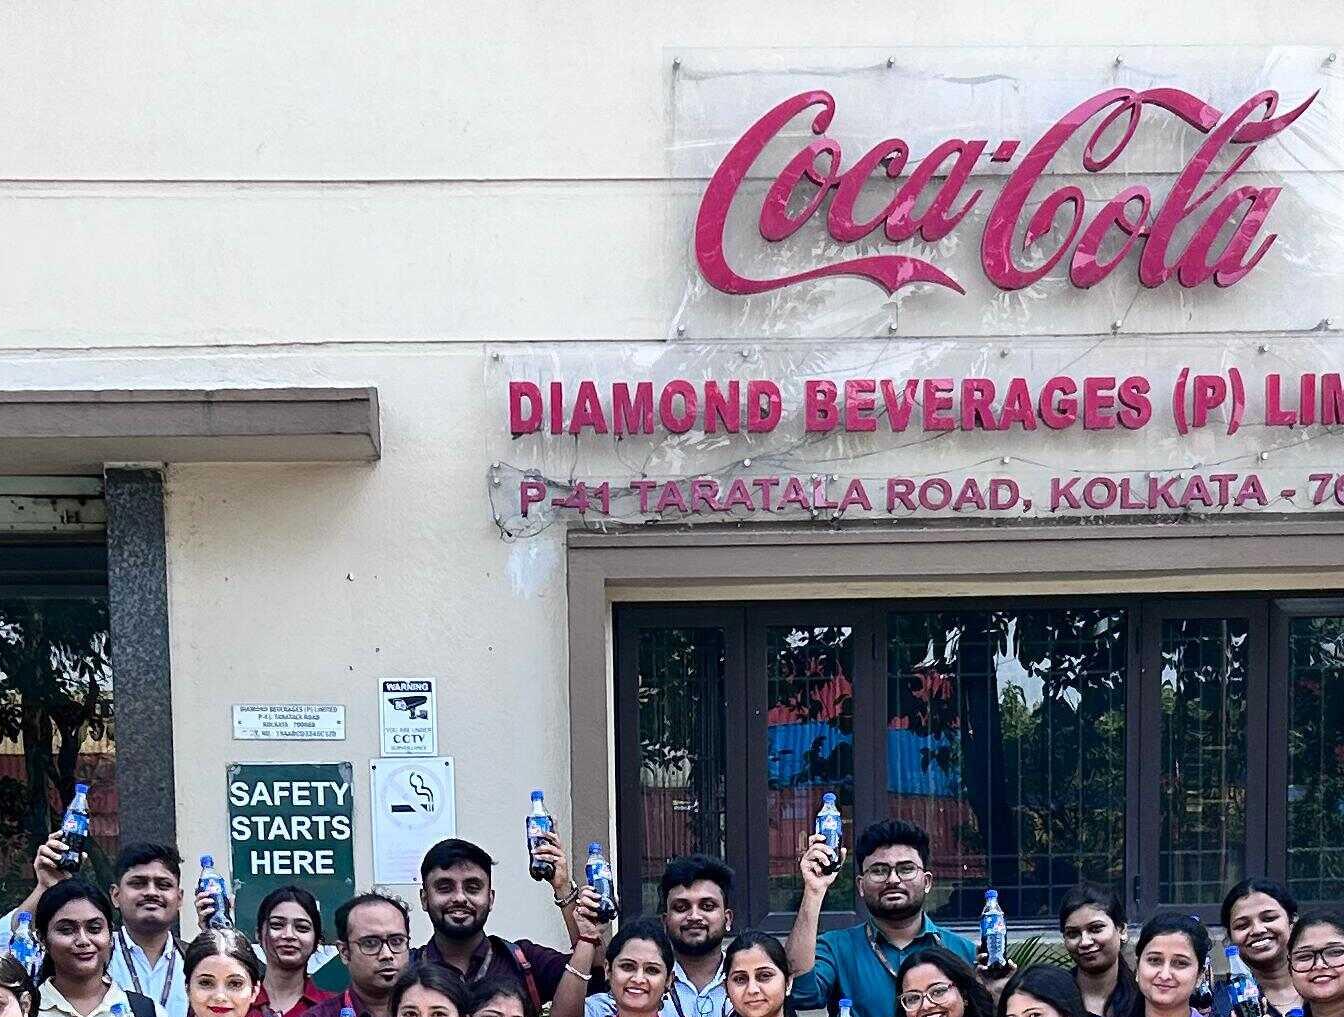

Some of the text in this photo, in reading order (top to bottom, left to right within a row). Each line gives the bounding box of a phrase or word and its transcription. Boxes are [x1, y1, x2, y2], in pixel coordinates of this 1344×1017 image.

[694, 87, 1320, 296] Coca-Cola
[509, 379, 783, 437] DIAMOND
[804, 375, 1153, 434] BEVERAGES
[1173, 367, 1246, 435] (P)
[520, 481, 611, 513] P-41
[634, 477, 871, 514] TARATALA
[887, 477, 1031, 514] ROAD,
[1050, 474, 1266, 511] KOLKATA
[386, 683, 429, 691] WARNING
[393, 734, 425, 743] CCTV
[230, 781, 349, 807] SAFETY
[231, 815, 351, 841] STARTS
[251, 850, 335, 875] HERE
